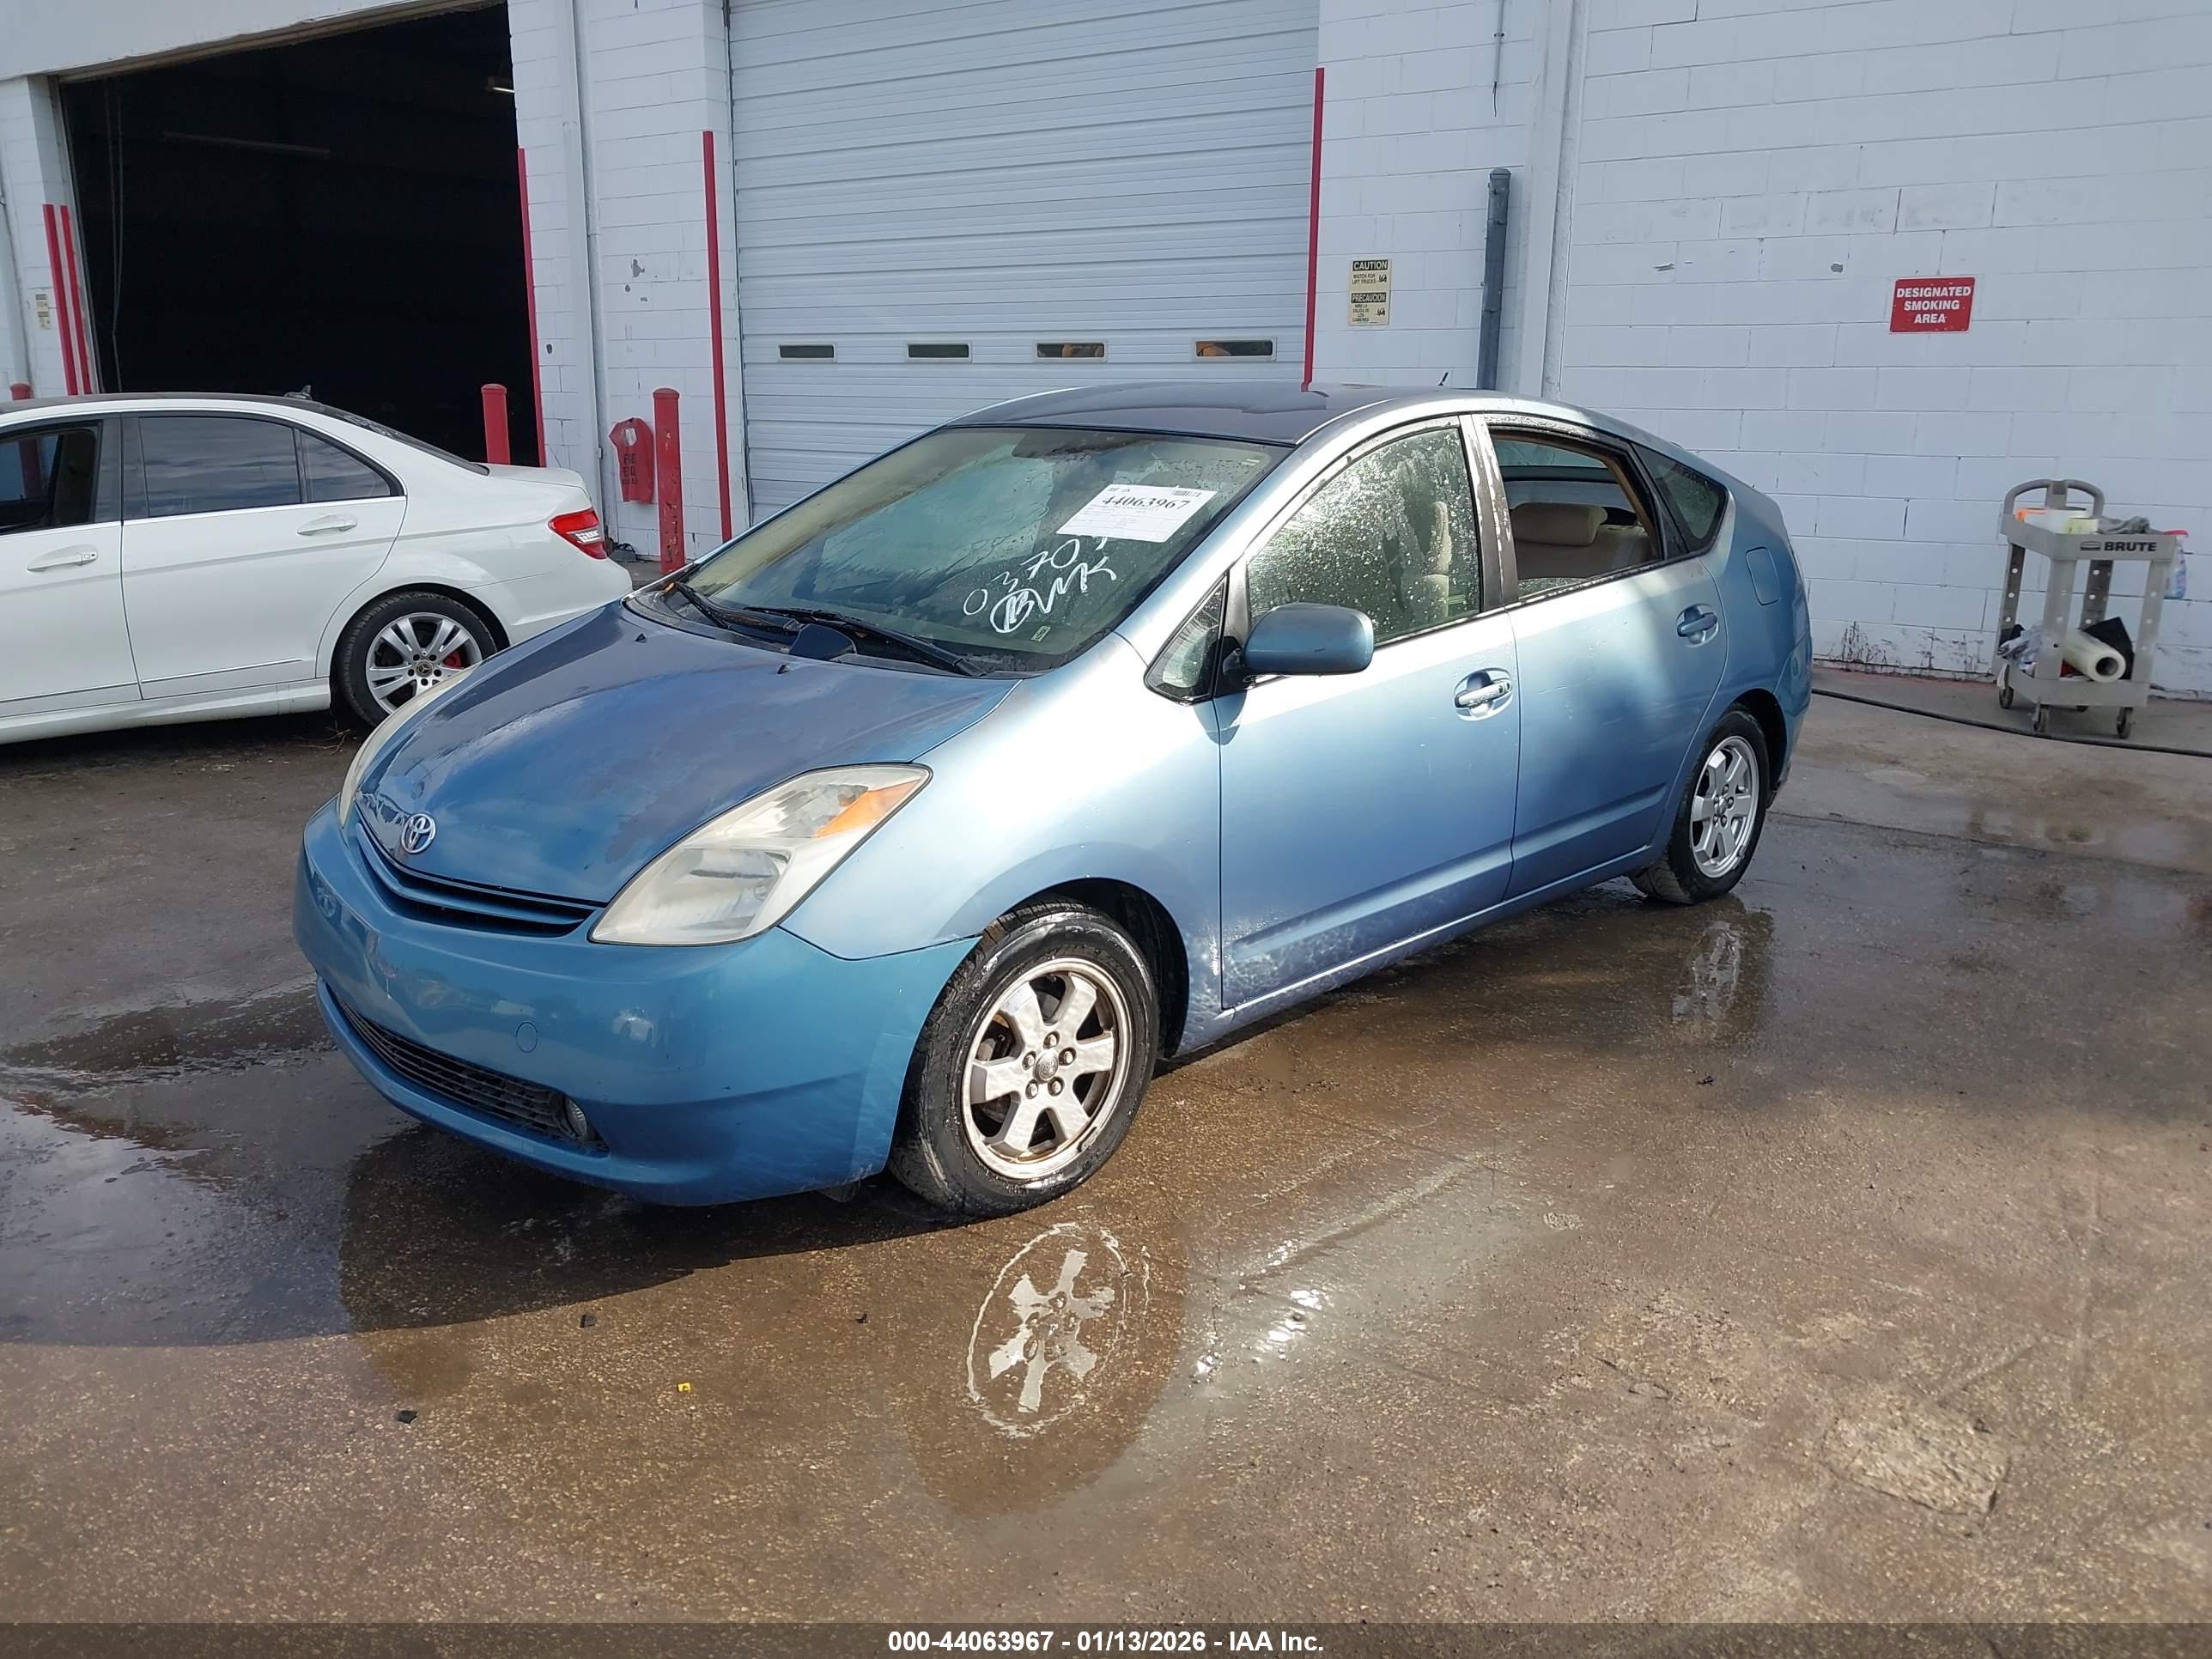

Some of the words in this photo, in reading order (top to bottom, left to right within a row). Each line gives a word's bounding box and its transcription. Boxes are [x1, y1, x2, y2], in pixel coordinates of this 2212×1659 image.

[1354, 261, 1387, 270] CAUTION
[1896, 286, 1972, 298] DESIGNATED
[1904, 300, 1960, 311] SMOKING
[1914, 313, 1946, 324] AREA
[1102, 495, 1192, 510] 44063967
[2105, 542, 2158, 552] BRUTE
